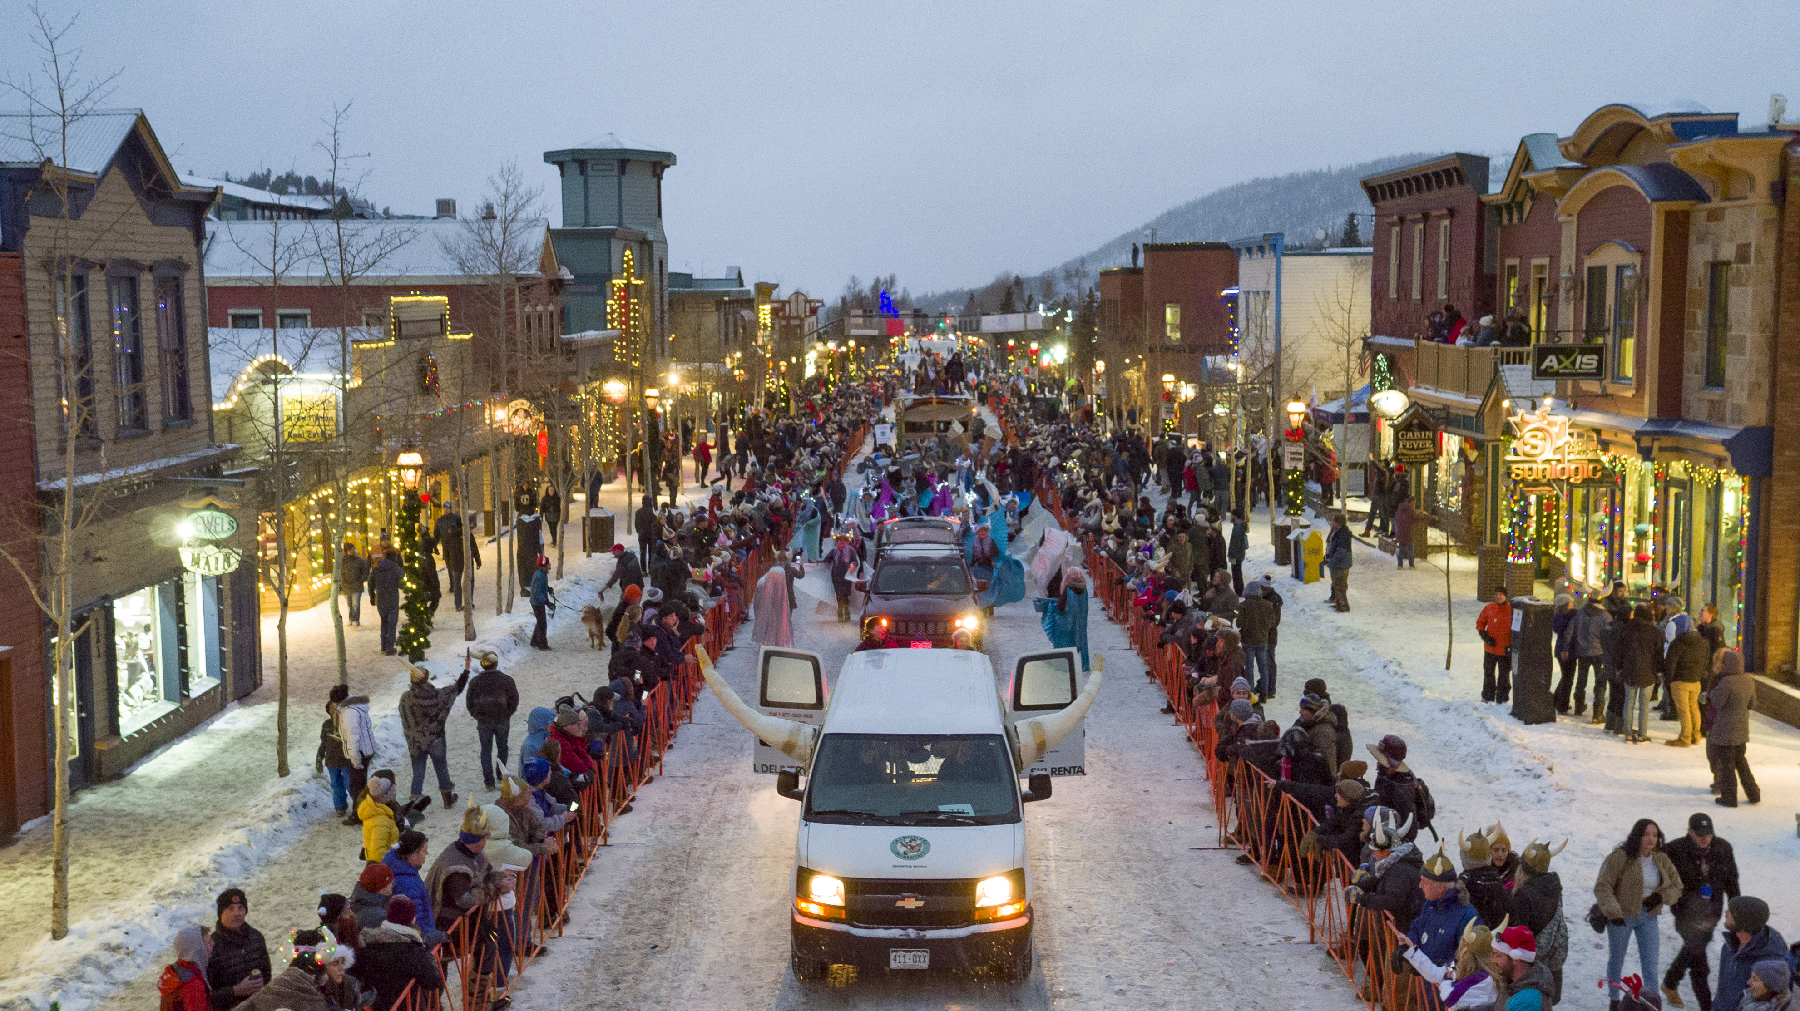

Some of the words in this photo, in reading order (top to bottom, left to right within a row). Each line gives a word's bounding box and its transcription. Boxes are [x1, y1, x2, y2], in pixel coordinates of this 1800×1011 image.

[1540, 349, 1599, 371] AXIS
[1399, 430, 1433, 440] CABIN
[1399, 440, 1433, 449] FEVER
[1511, 461, 1602, 483] sunlogic
[191, 516, 235, 535] EWELS
[191, 551, 231, 573] MAIN
[761, 764, 807, 776] DELRY
